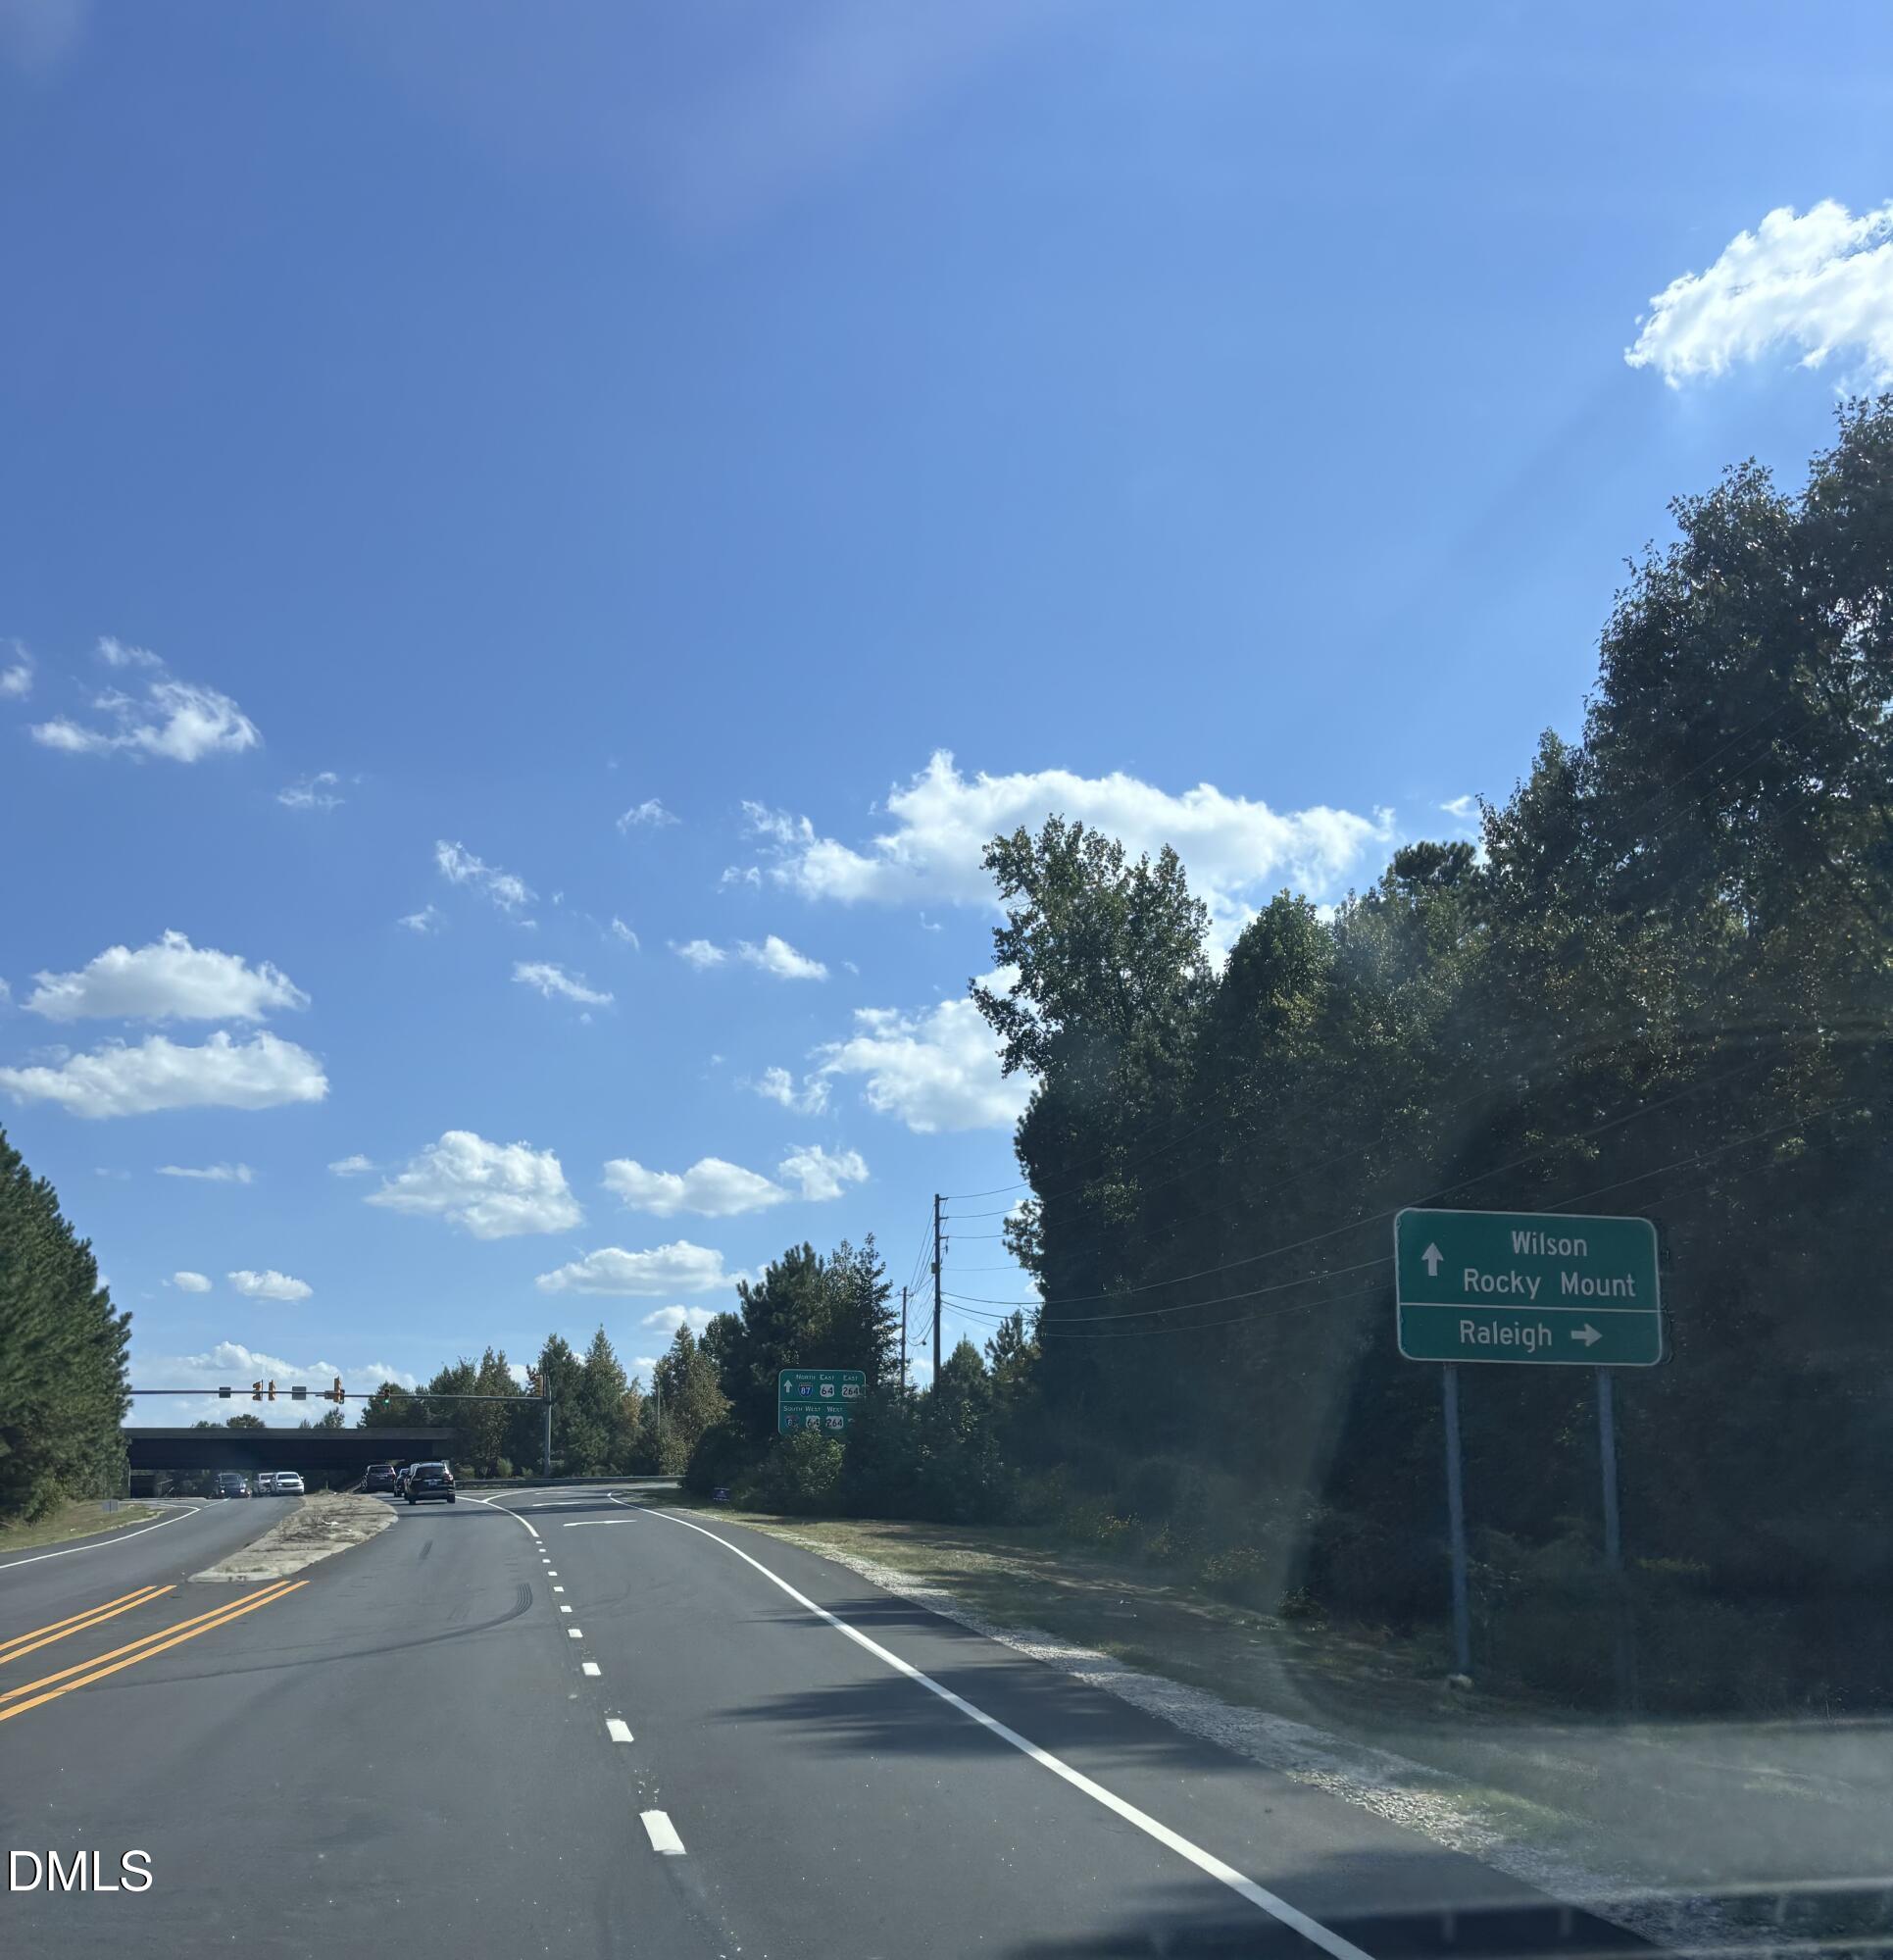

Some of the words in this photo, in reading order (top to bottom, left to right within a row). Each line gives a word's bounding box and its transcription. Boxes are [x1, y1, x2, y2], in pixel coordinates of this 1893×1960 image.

[1512, 1231, 1587, 1257] Wilson
[1464, 1268, 1542, 1300] Rocky
[1561, 1271, 1636, 1297] Mount
[1460, 1320, 1553, 1353] Raleigh
